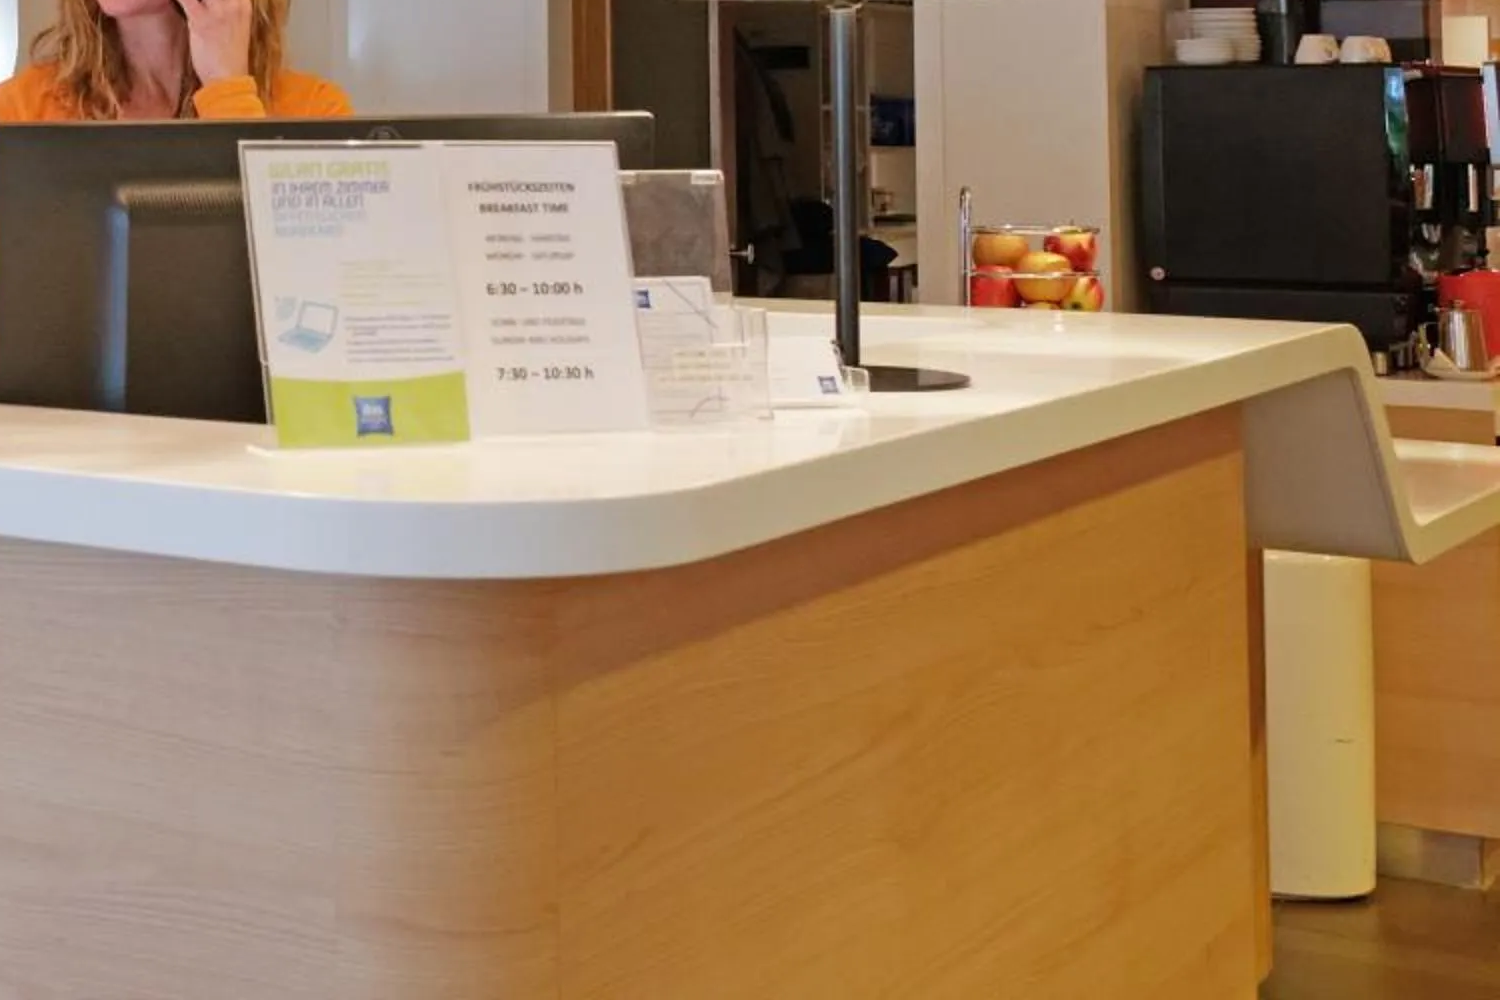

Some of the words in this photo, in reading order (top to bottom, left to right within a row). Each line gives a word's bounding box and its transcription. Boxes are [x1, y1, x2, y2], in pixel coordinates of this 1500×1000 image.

[336, 180, 390, 193] ZIMMER
[479, 203, 539, 213] BREAKFAST
[542, 203, 568, 213] TIME
[486, 281, 517, 295] 6:30
[532, 281, 571, 295] 10:00
[573, 281, 583, 295] h
[497, 366, 528, 381] 7:30
[543, 366, 582, 380] 10:30
[583, 365, 595, 380] h
